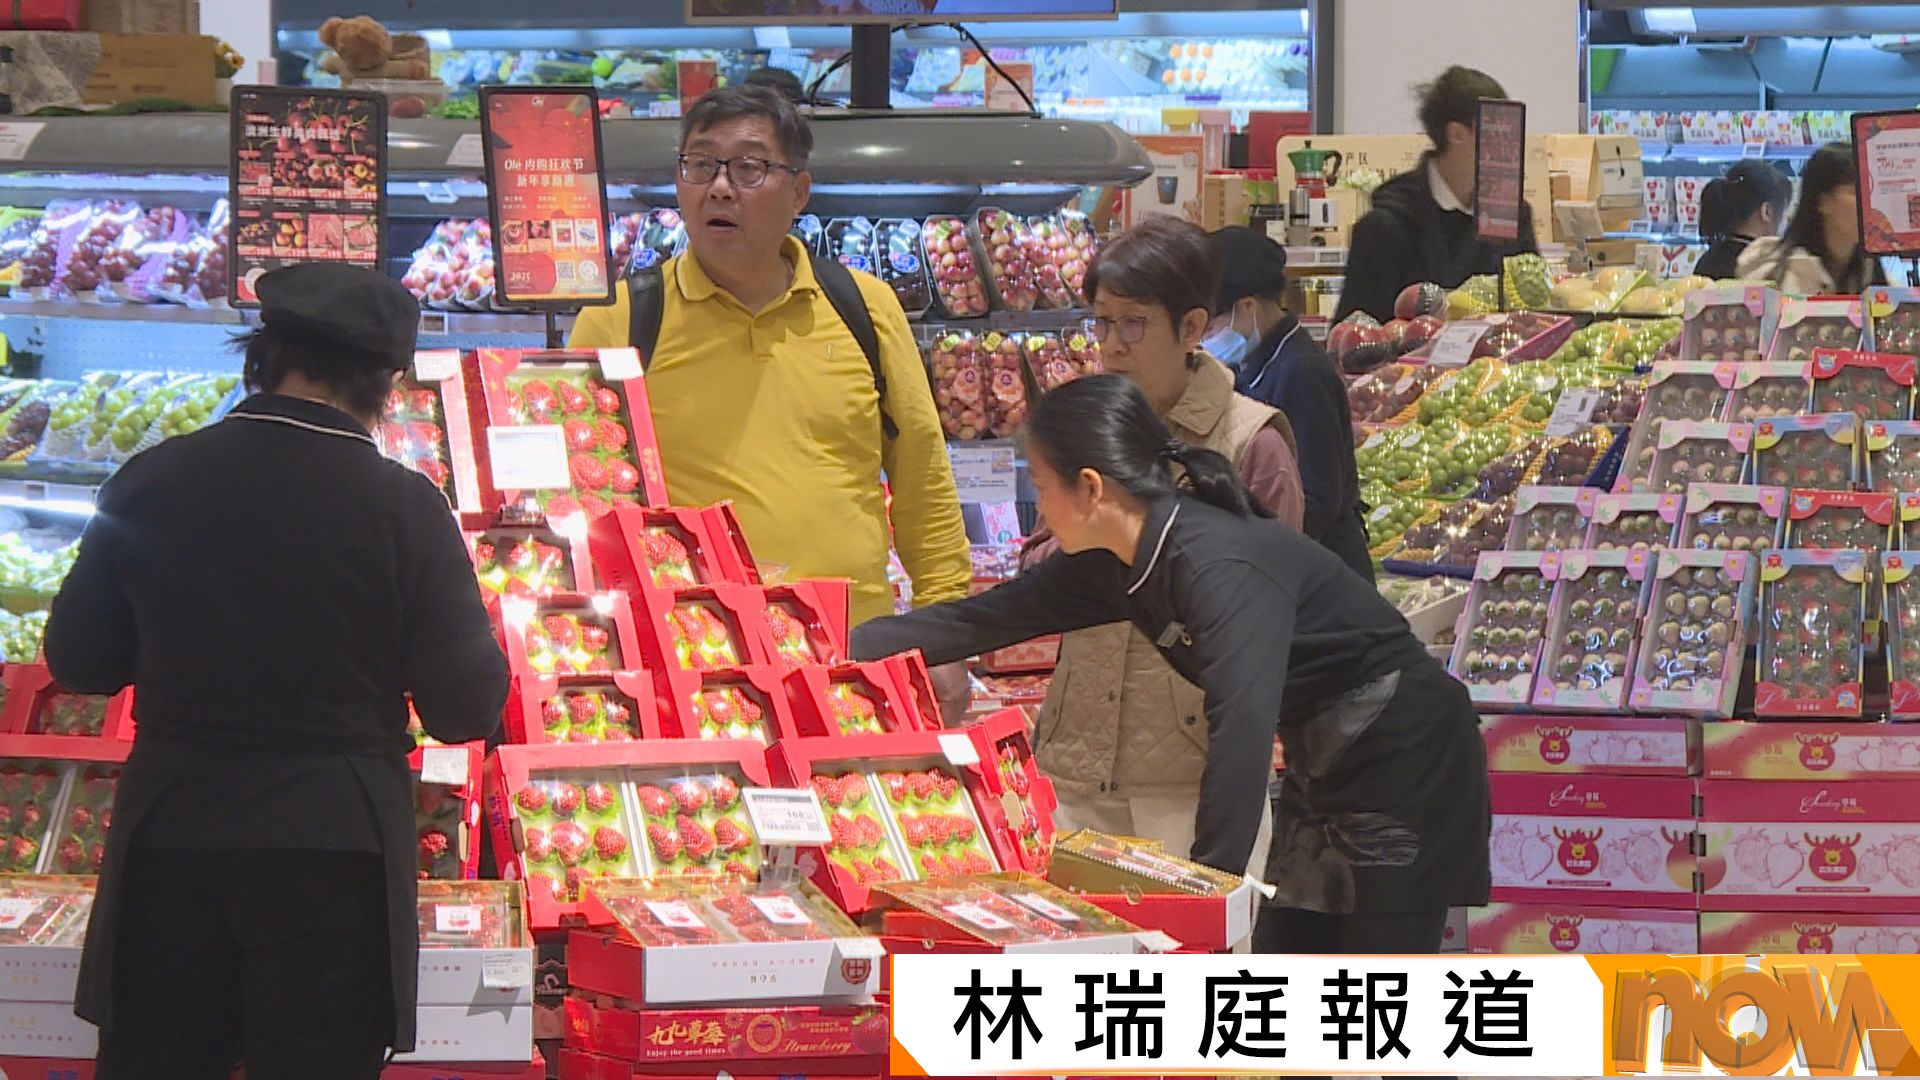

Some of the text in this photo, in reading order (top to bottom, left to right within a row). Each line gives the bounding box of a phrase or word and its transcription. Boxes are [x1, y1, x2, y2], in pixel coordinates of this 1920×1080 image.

[525, 157, 584, 172] 内购狂欢节
[510, 272, 531, 284] 2025
[646, 1047, 669, 1058] Enjoy
[670, 1047, 683, 1057] the
[684, 1047, 703, 1058] good
[781, 1038, 852, 1054] Strawberry
